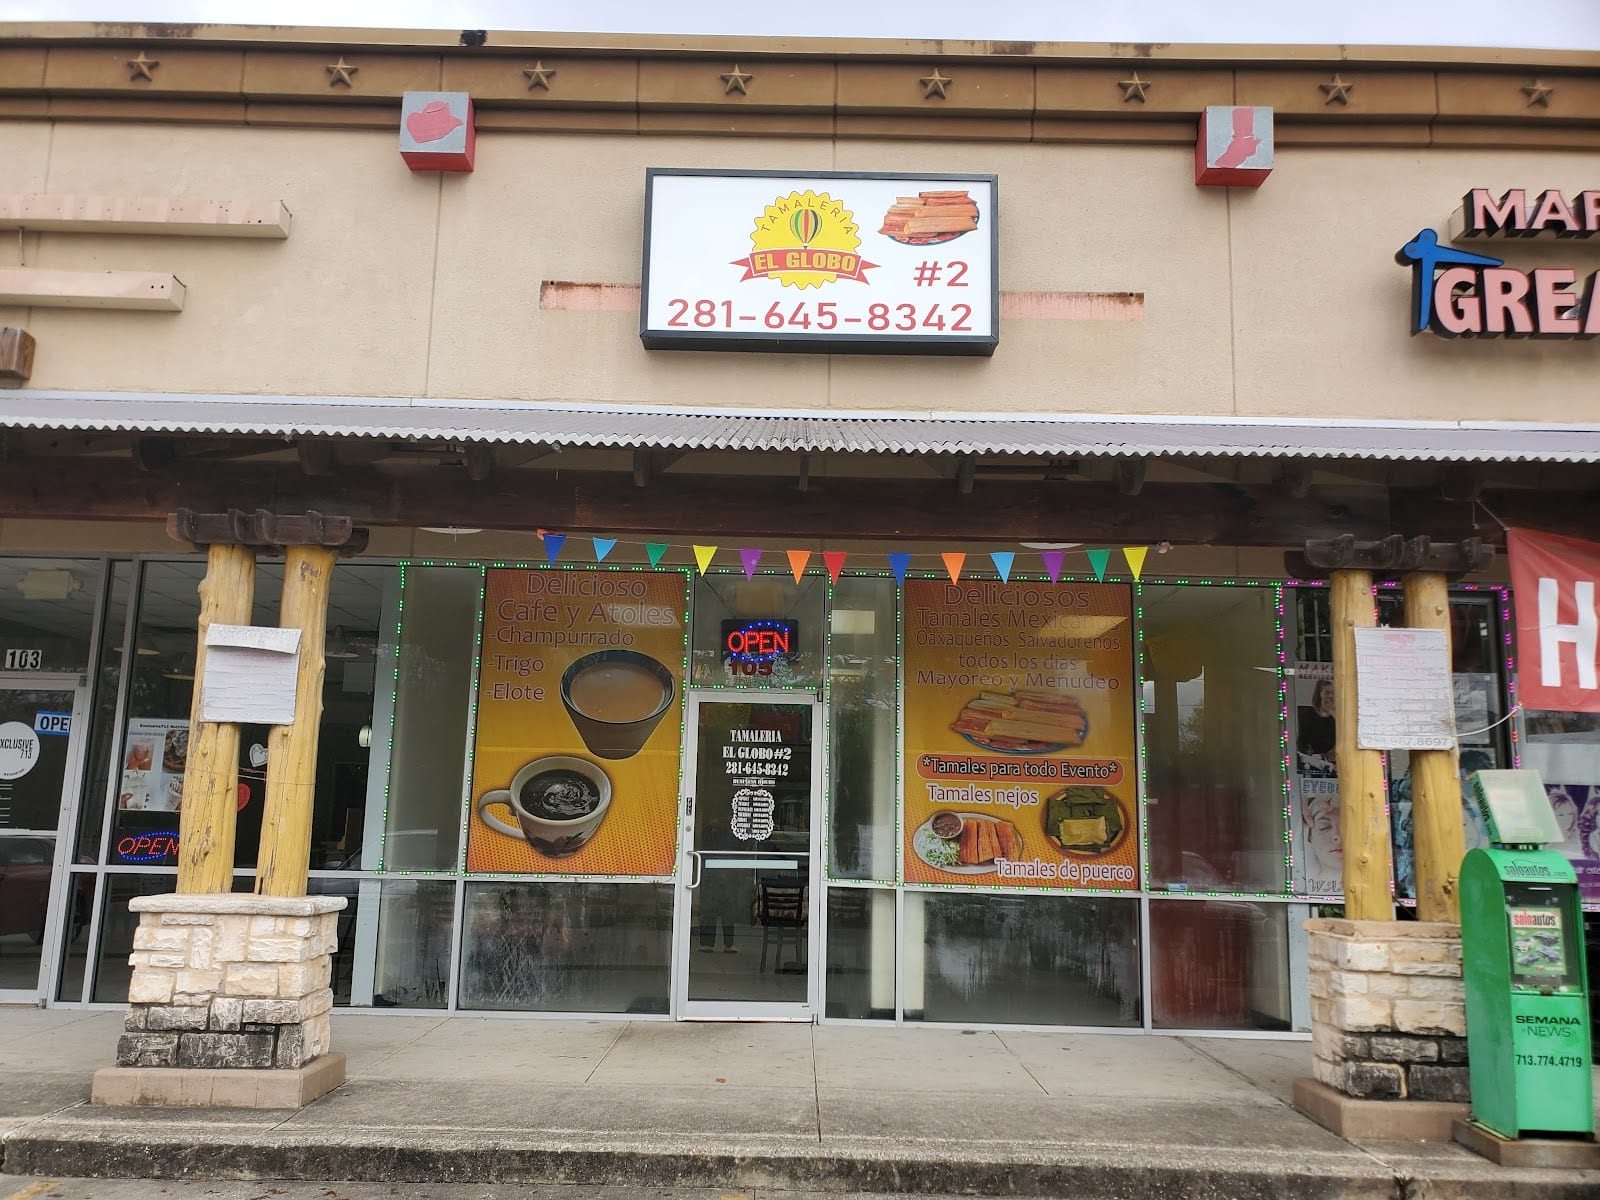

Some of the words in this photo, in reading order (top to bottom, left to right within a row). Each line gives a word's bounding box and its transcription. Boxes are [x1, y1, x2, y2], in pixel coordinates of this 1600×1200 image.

[760, 198, 853, 235] TAMALERIA
[754, 253, 779, 271] EL
[785, 252, 856, 272] GLOBO
[913, 260, 969, 288] #2
[667, 298, 973, 332] 281-645-8342
[526, 571, 647, 598] Delicioso
[944, 584, 1090, 608] Deliciosos
[497, 598, 558, 622] Cafe
[566, 605, 581, 629] y
[588, 601, 676, 625] Atoles
[916, 607, 1001, 628] Tamales
[727, 631, 790, 654] OPEN
[916, 629, 1009, 649] Oaxaqueños
[9, 650, 40, 668] 103
[958, 652, 1008, 670] todos
[1014, 652, 1038, 670] los
[1043, 653, 1078, 671] dias
[917, 670, 1003, 690] Mayoreo
[1008, 674, 1021, 691] y
[1026, 672, 1120, 690] Menudeo
[40, 716, 72, 731] OPE
[730, 729, 782, 742] TAMALERIA
[20, 749, 32, 760] 713
[722, 746, 736, 758] EL
[726, 761, 789, 776] 281-645-8342
[990, 761, 1020, 779] para
[1023, 761, 1057, 778] todo
[926, 784, 992, 803] Tamales
[996, 788, 1038, 808] nejos
[995, 859, 1056, 878] Tamales
[1060, 861, 1078, 879] de
[1081, 864, 1134, 883] puerco
[1504, 861, 1551, 877] soloautos
[1513, 909, 1555, 926] soloautos
[1515, 1016, 1581, 1025] SEMANA
[1527, 1026, 1571, 1037] NEWS
[1515, 1054, 1582, 1067] 713.774.4719
